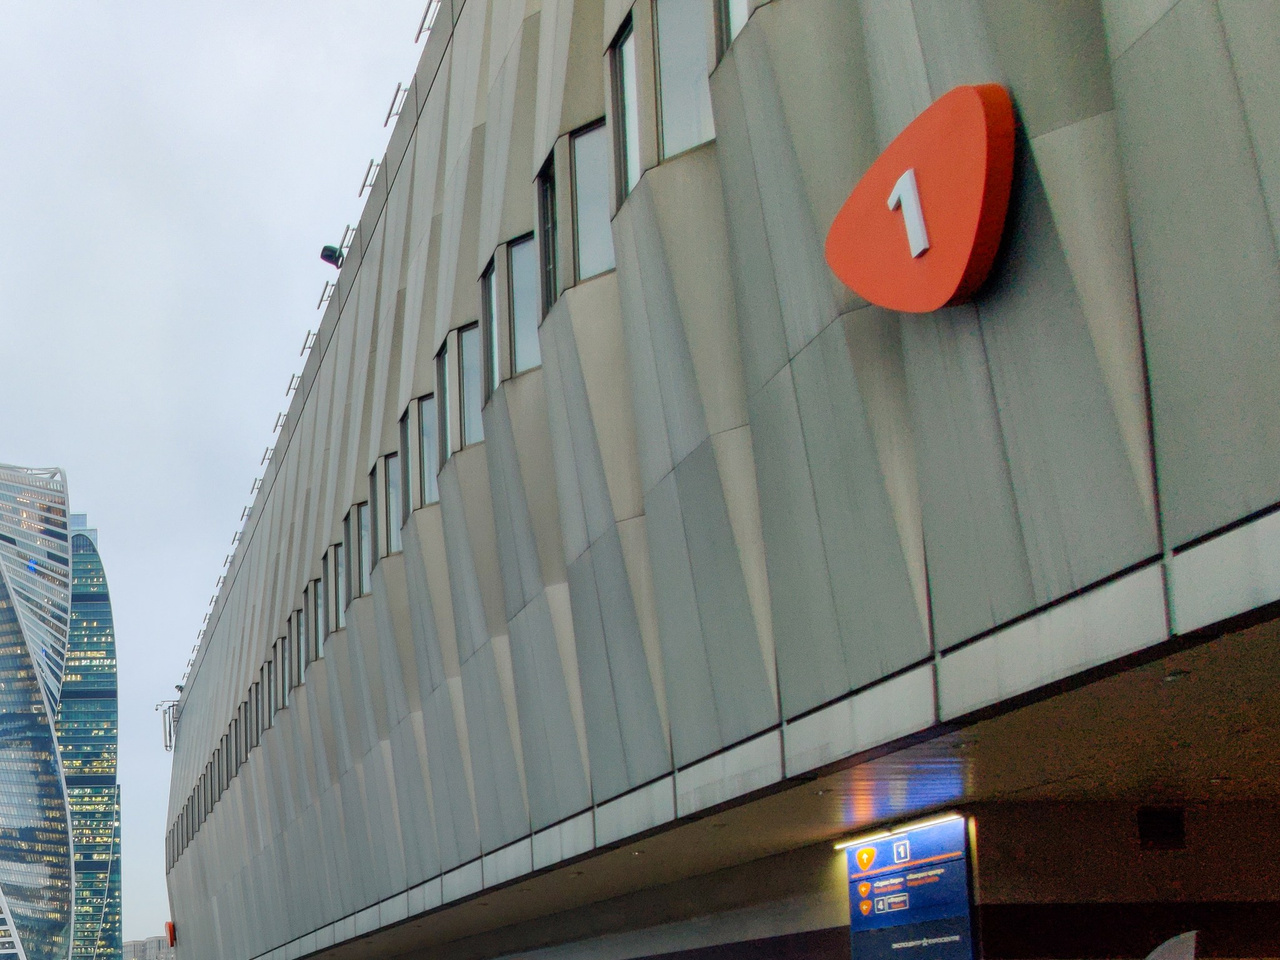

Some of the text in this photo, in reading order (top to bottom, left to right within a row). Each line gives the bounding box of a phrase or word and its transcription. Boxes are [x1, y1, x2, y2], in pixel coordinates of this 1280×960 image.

[887, 167, 930, 259] 1
[898, 845, 906, 858] 1
[877, 900, 884, 910] 4
